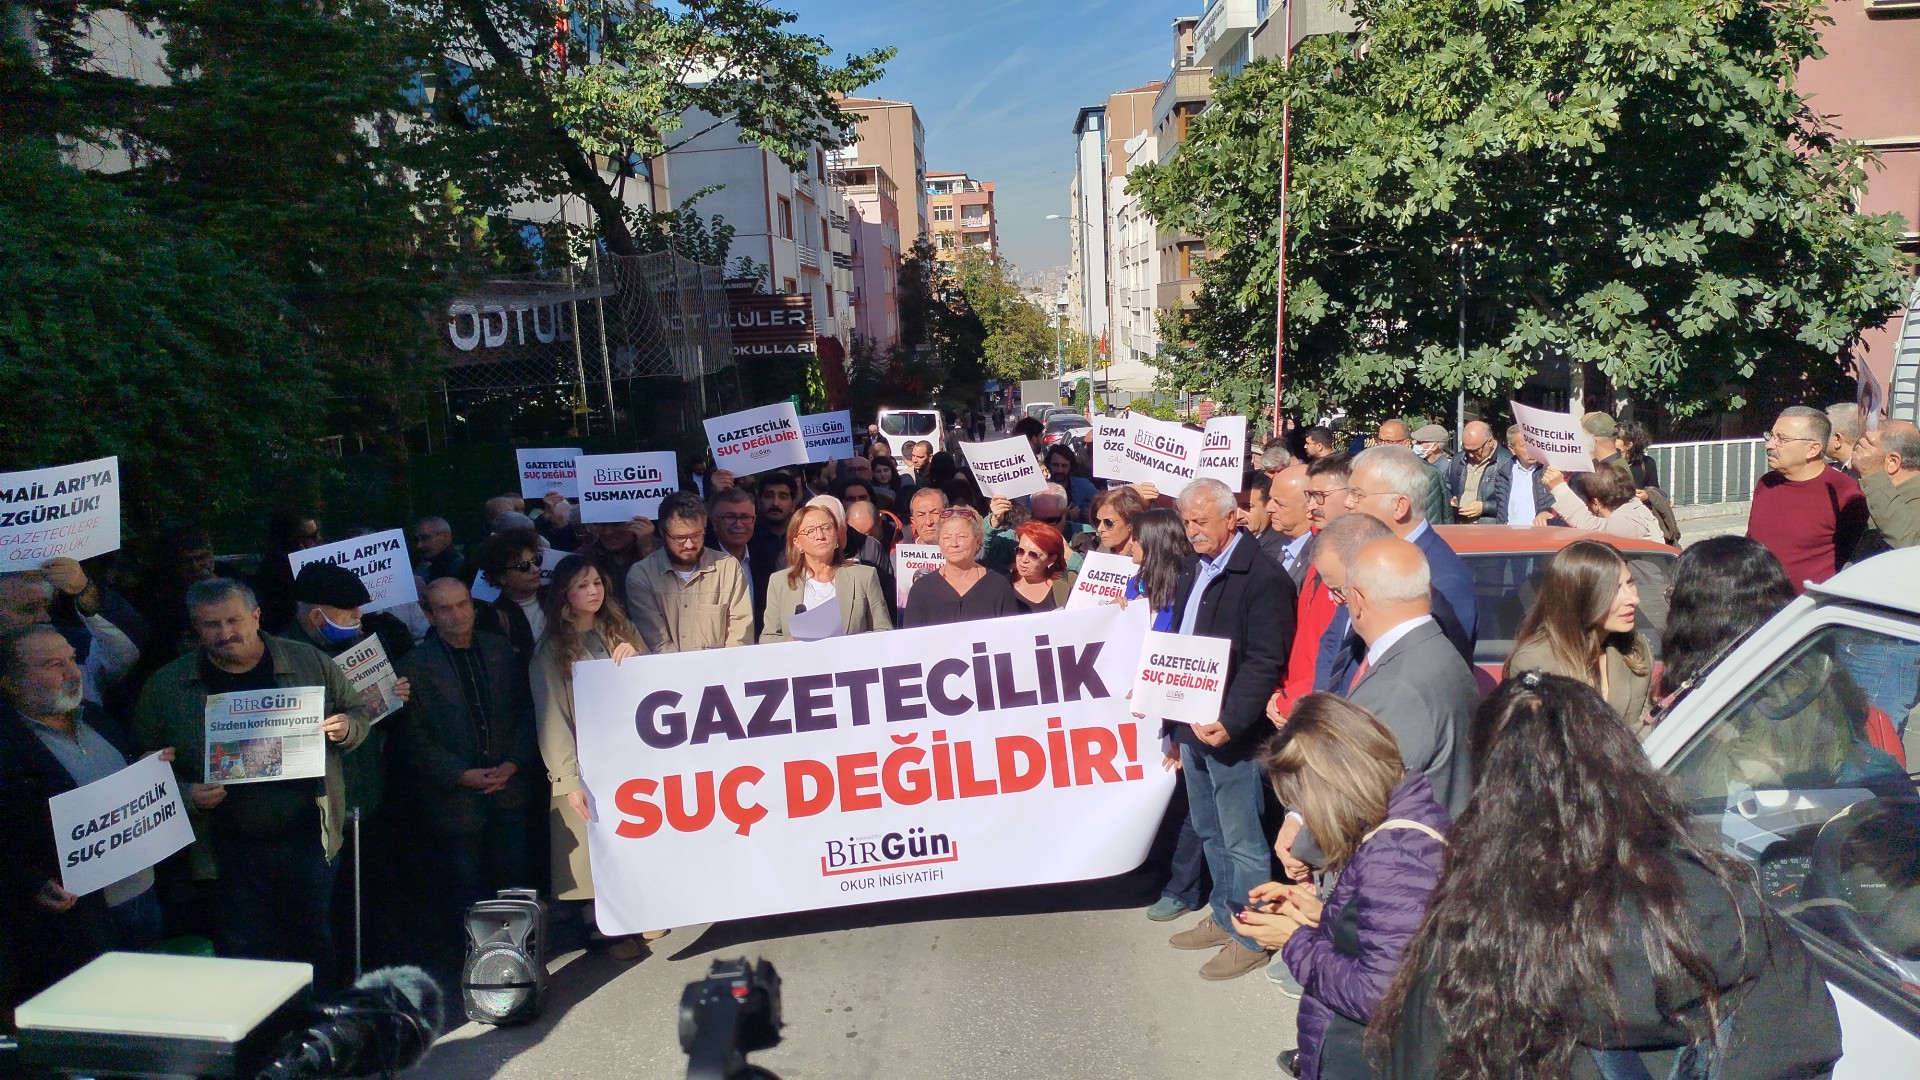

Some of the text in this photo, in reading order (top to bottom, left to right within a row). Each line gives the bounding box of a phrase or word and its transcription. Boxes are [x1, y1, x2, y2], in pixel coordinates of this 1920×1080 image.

[717, 418, 791, 443] GAZETECİLİK
[1099, 424, 1126, 438] İSMA
[1205, 430, 1228, 447] Gün
[1522, 422, 1575, 441] GAZETECİLİK
[716, 430, 798, 457] SUÇ DEĞİLDİR!
[805, 435, 851, 449] SMAYACAK!
[1523, 434, 1582, 454] SUÇ DEĞİLDİR!
[972, 454, 1026, 471] GAZETECİLİK
[1125, 448, 1194, 479] SUSMAYACAK!
[1200, 456, 1239, 468] YACAK!
[523, 469, 576, 480] SUÇ DEĞİLDİ
[987, 465, 1034, 484] DEĞİLDİR!
[0, 470, 112, 504] MAİL ARI'YA
[584, 487, 674, 502] SUSMAYACAK!
[0, 495, 101, 528] ZGÜRLÜK!
[353, 539, 400, 561] ARI'YA
[901, 549, 929, 559] İSMAİL
[1087, 569, 1131, 586] GAZETECİ
[1078, 581, 1123, 599] SUÇ DEĞİL
[340, 647, 375, 671] RGün
[1150, 653, 1219, 675] GAZETECİLİK
[349, 657, 390, 686] orkmuyor
[1141, 669, 1219, 692] SUÇ DEĞİLDİR!
[635, 634, 1111, 750] GAZETECİLİK
[210, 716, 319, 732] Sizden korkmuyoruz
[614, 716, 1144, 839] SUÇ DEĞİLDİR!
[71, 781, 168, 841] GAZETECİLİK
[66, 800, 177, 868] SUÇ DEĞİLDİR!
[840, 867, 944, 892] OKUR İNİSİYATİFİ
